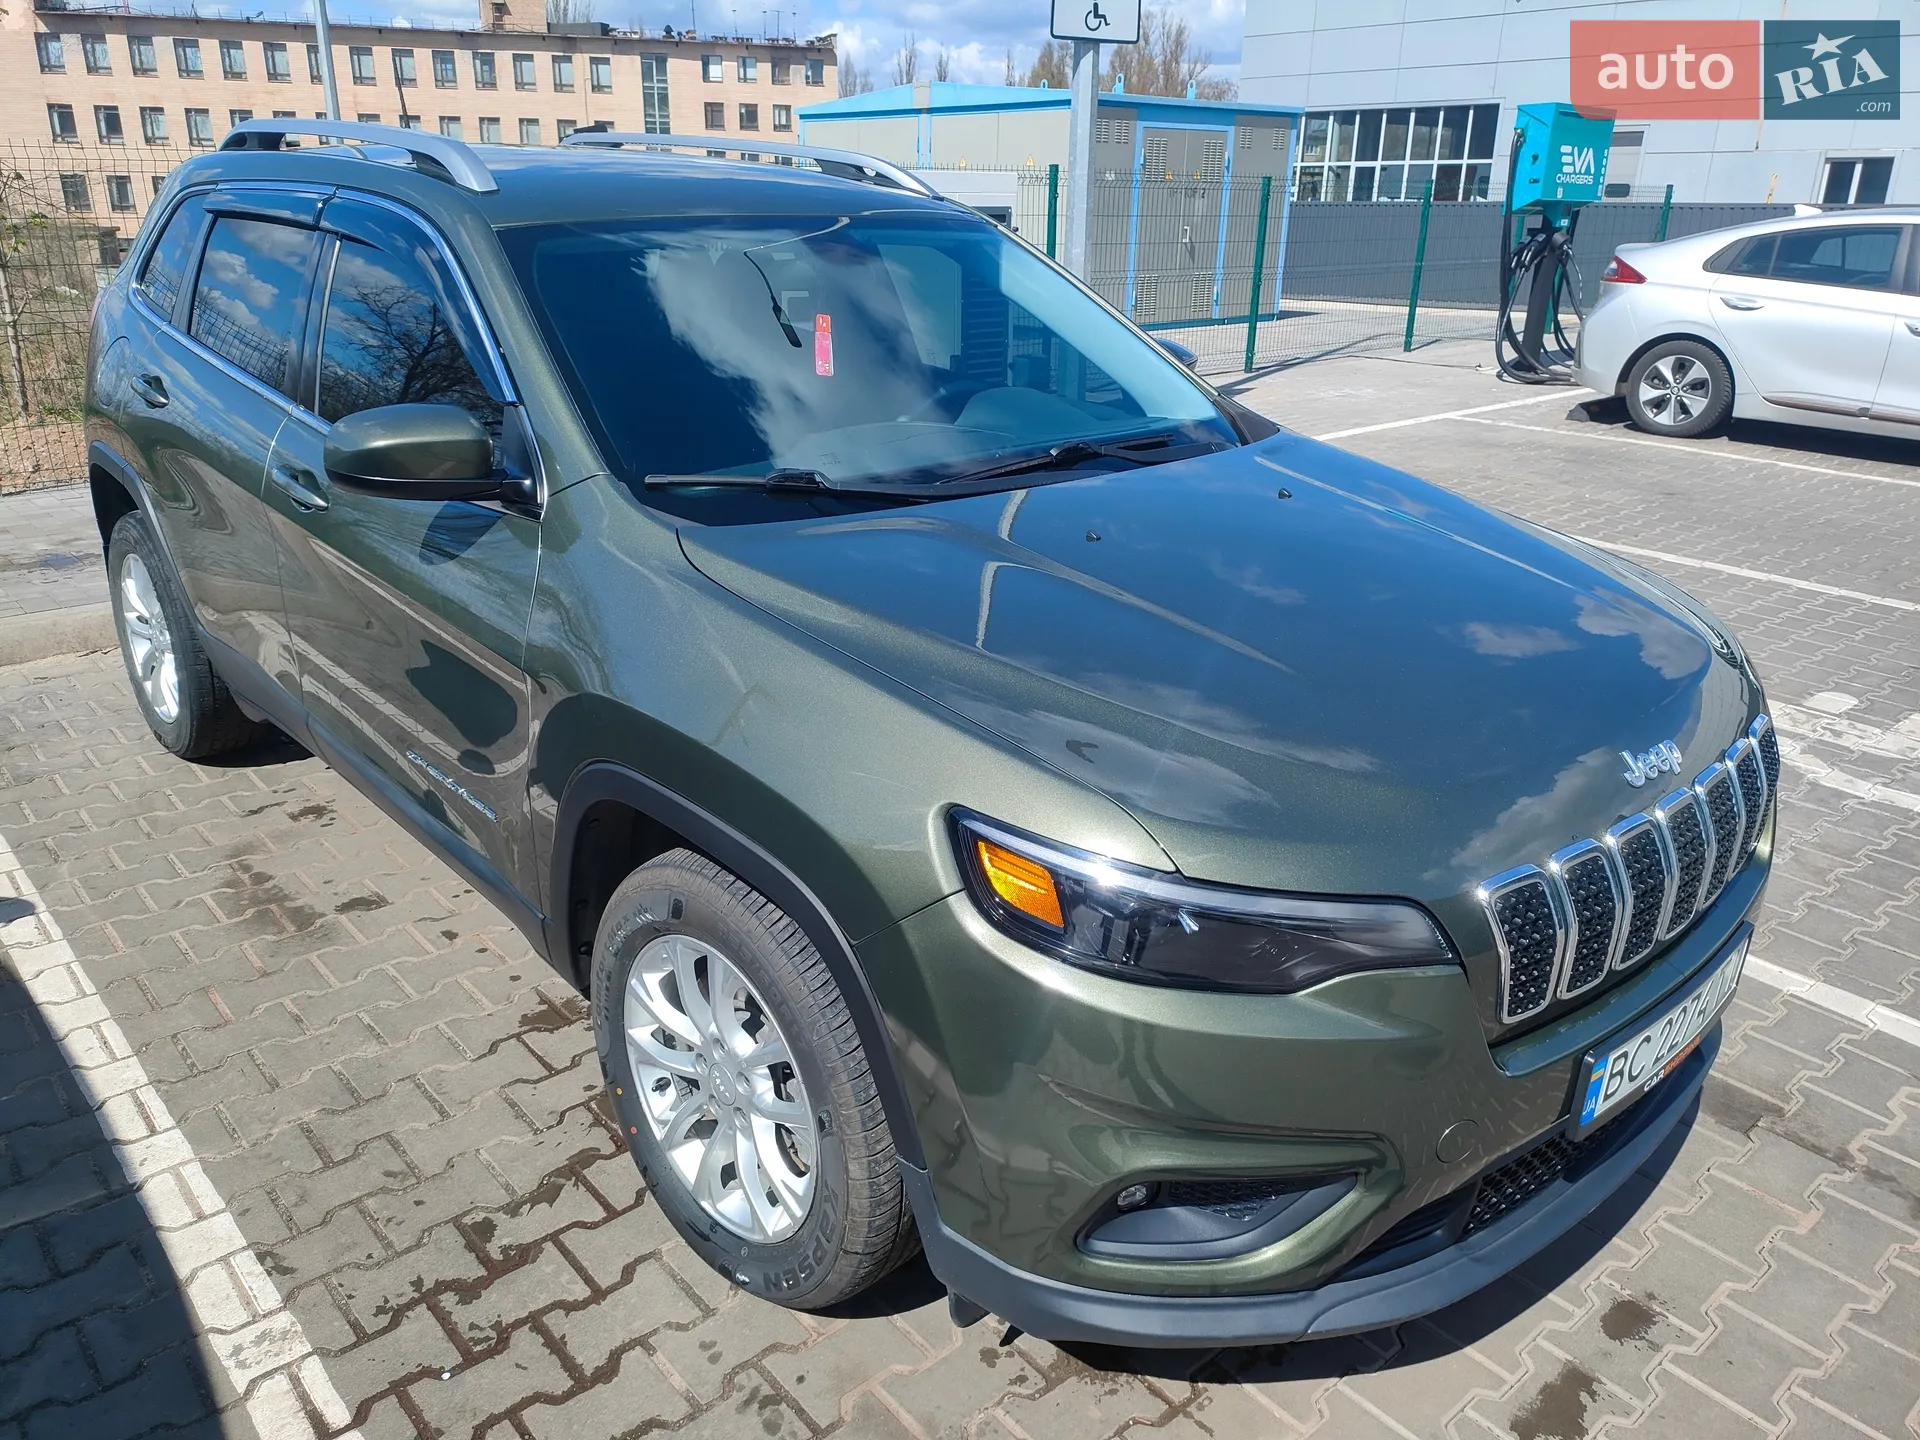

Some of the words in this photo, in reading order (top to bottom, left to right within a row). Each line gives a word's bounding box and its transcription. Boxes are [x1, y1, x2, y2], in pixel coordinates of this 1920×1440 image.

[1560, 145, 1595, 174] EVA
[1556, 173, 1594, 185] CHARGERS
[1618, 739, 1683, 788] Jeep
[1603, 1034, 1652, 1101] BC
[1652, 978, 1715, 1068] 2274
[1583, 1099, 1596, 1115] UA
